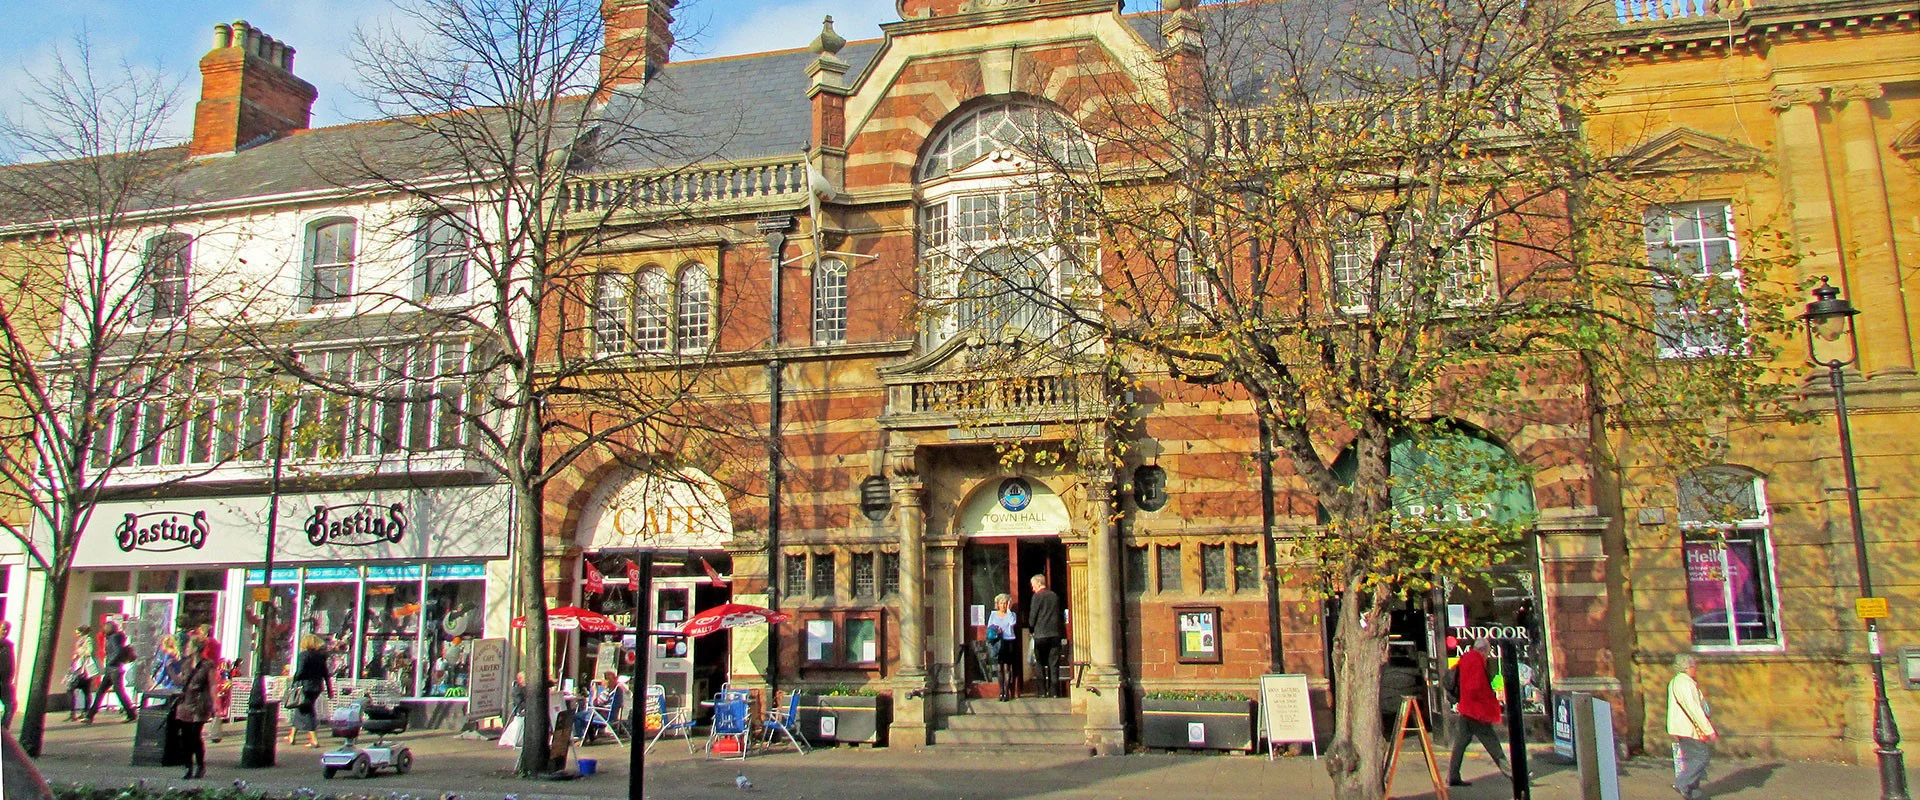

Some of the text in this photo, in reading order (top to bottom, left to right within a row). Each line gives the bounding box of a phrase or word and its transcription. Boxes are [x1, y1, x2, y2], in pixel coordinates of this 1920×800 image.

[614, 505, 705, 536] CAFE
[984, 512, 1047, 523] TOWN HALL
[690, 624, 714, 636] WALL'S
[1456, 626, 1529, 640] INDOOR
